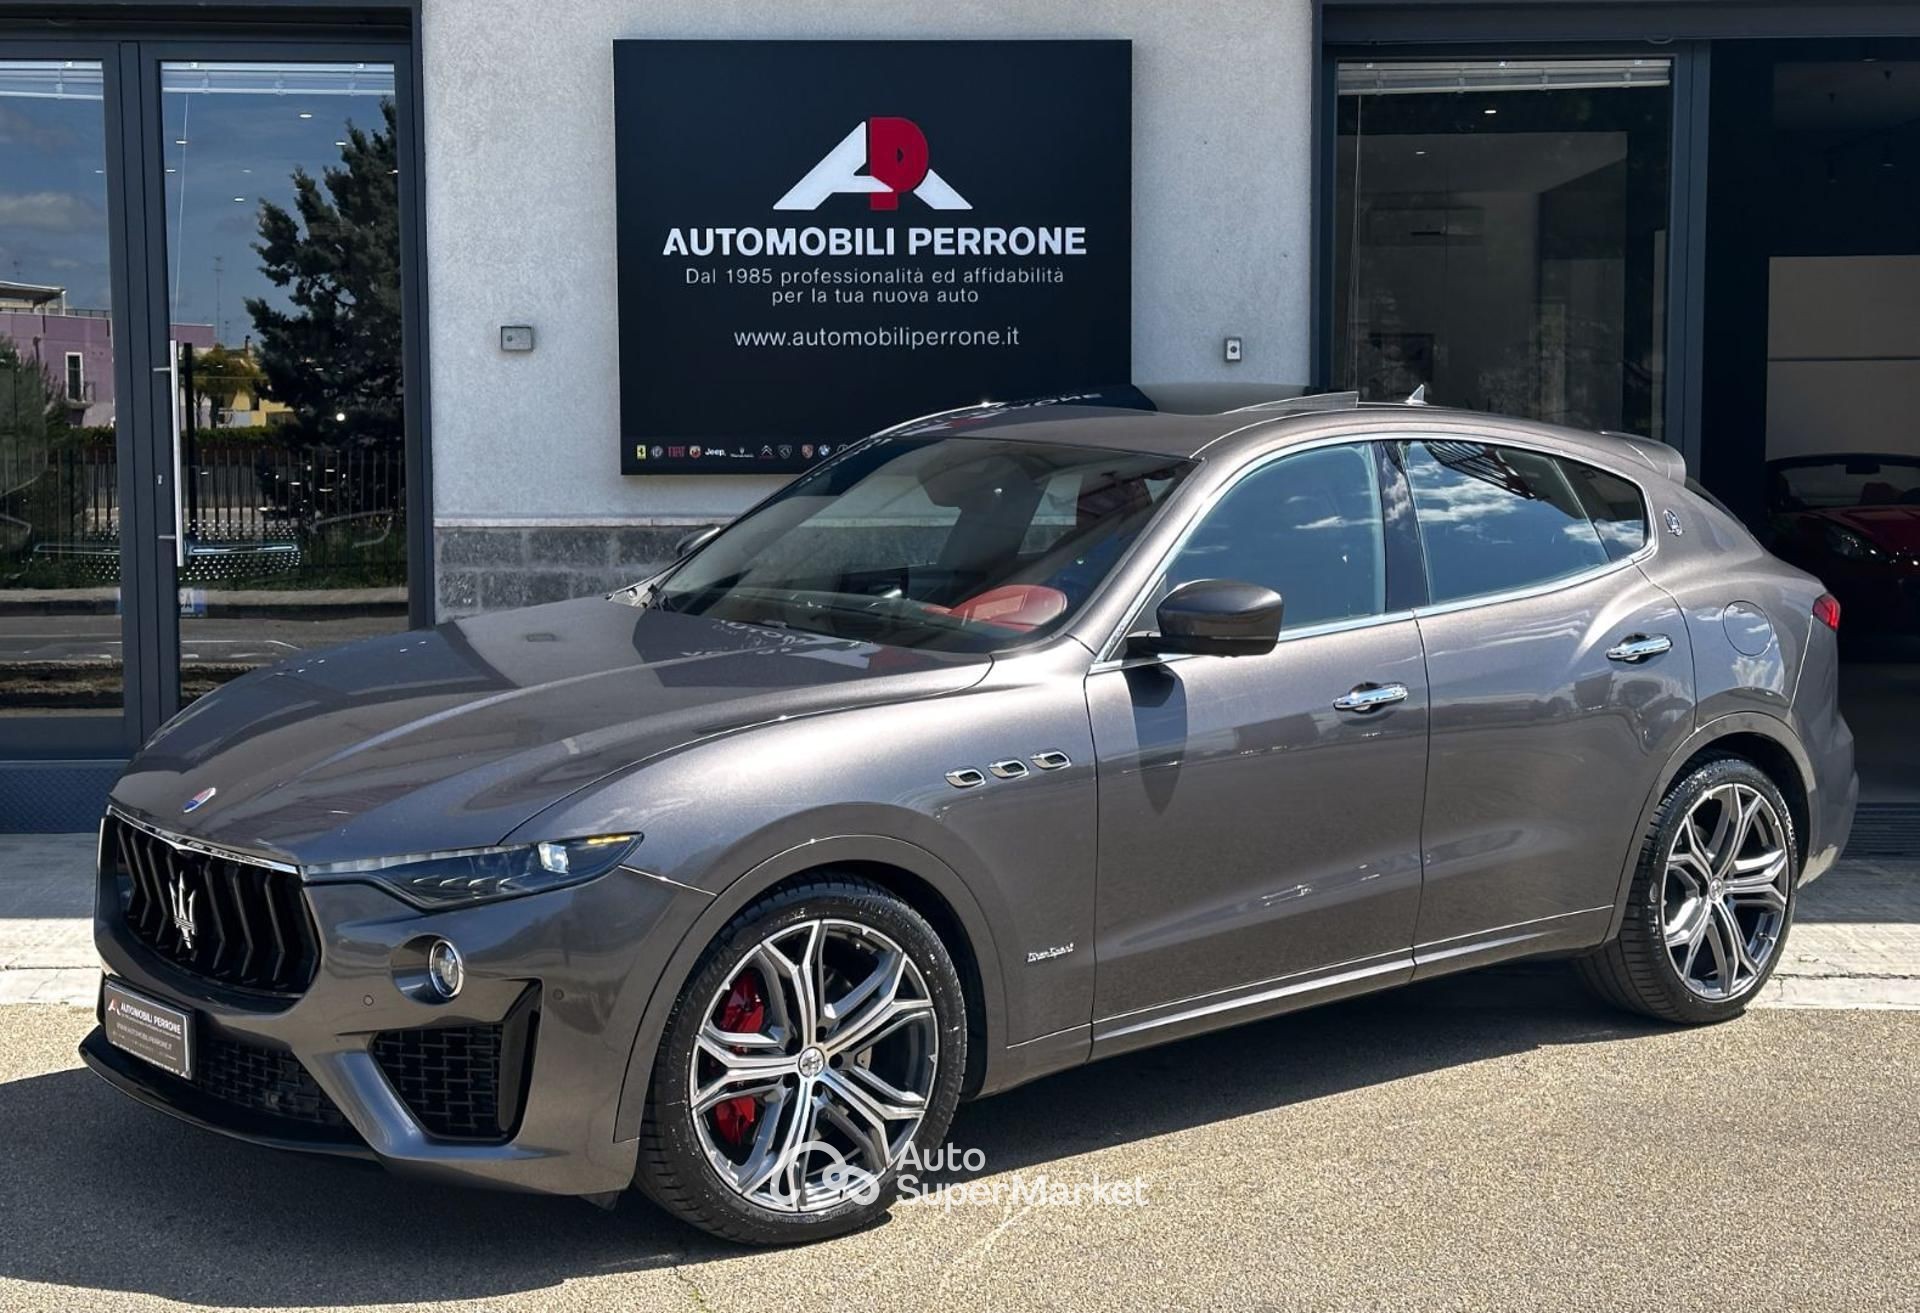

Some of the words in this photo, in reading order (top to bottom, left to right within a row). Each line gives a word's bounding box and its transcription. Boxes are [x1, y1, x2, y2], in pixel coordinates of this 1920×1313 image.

[662, 226, 895, 257] AUTOMOBILI
[908, 226, 1087, 256] PERRONE
[686, 267, 716, 284] Dal
[726, 267, 773, 284] 1985
[781, 267, 924, 288] professionalità
[931, 267, 955, 284] ed
[963, 267, 1064, 284] affidabilità
[772, 290, 804, 306] per
[811, 287, 827, 303] la
[834, 288, 864, 303] tua
[872, 290, 929, 303] nuova
[936, 287, 979, 303] auto
[733, 326, 1020, 350] www.automobiliperrone.it
[120, 1002, 153, 1024] AUTOMOBILI
[153, 1015, 182, 1034] PERRONE
